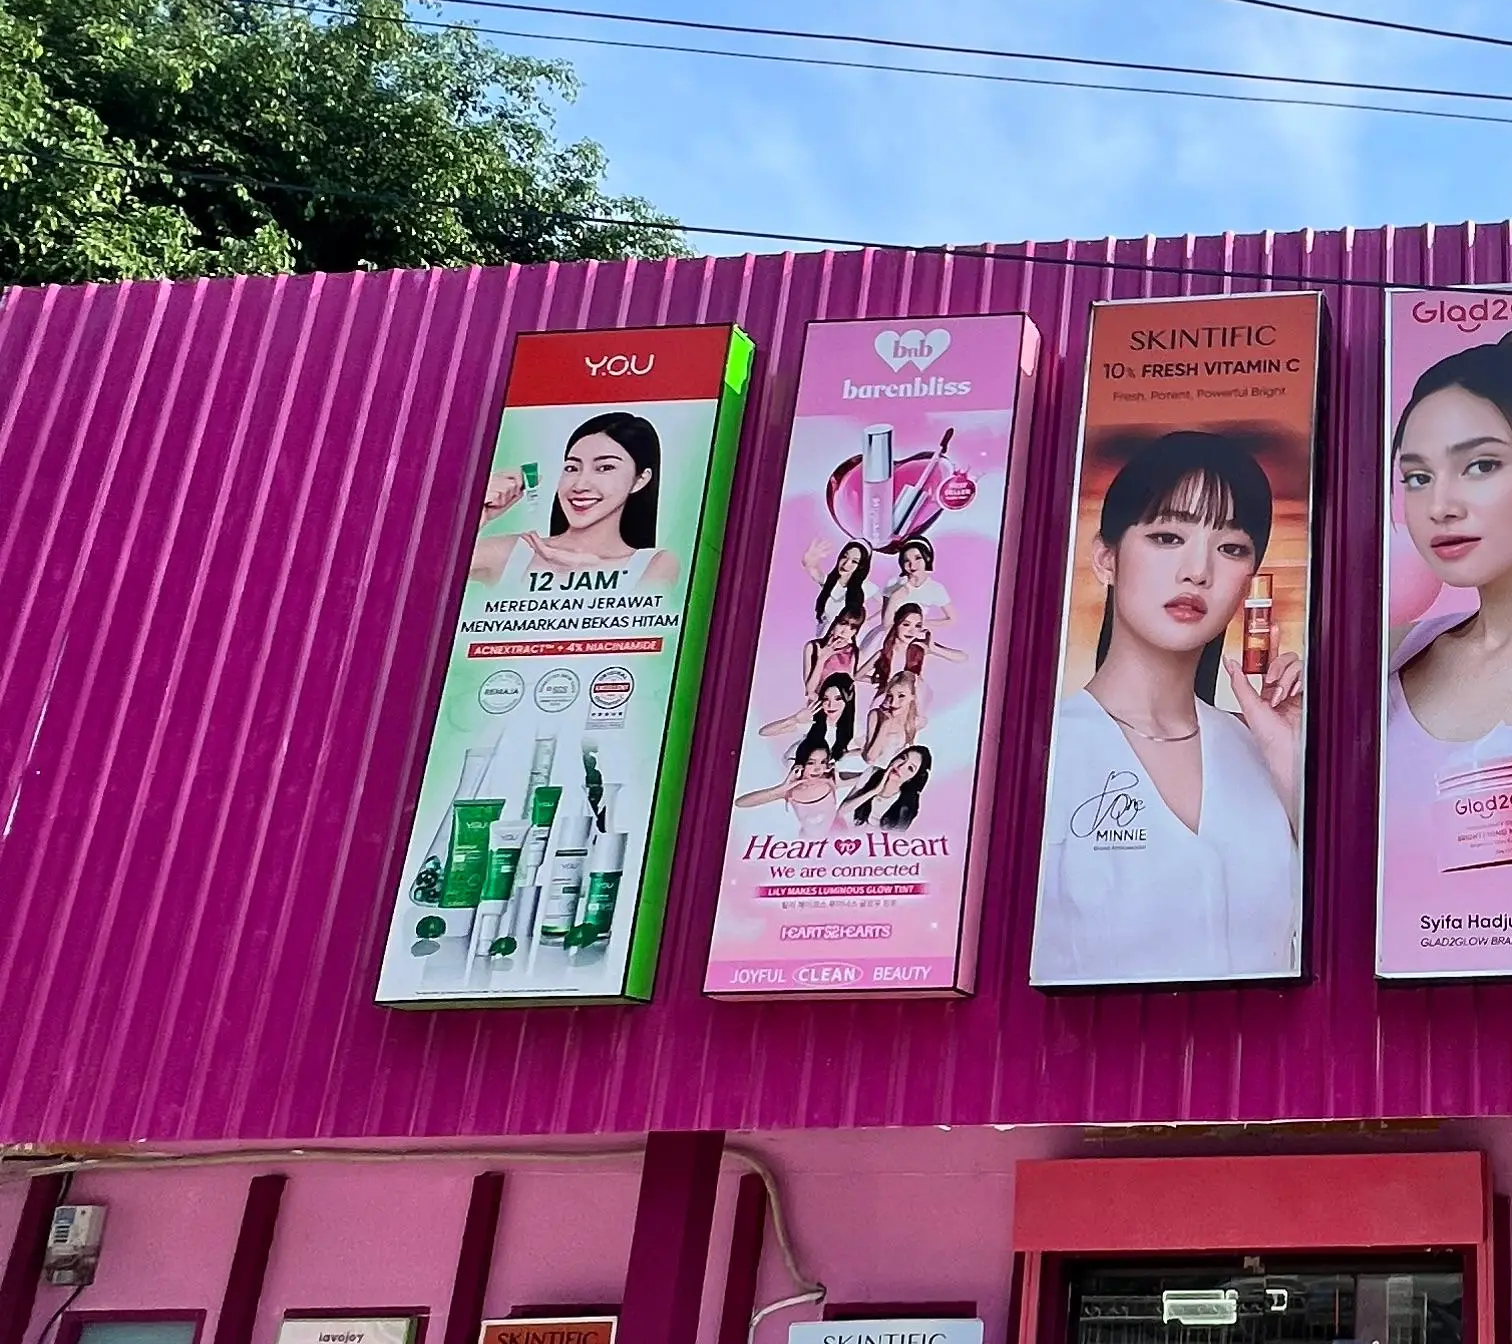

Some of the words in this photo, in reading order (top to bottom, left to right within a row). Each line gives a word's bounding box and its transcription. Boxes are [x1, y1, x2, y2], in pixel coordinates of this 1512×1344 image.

[1129, 325, 1277, 351] SKINTIFIC
[893, 340, 933, 358] bnb
[1103, 362, 1136, 379] 10%
[1141, 363, 1199, 378] FRESH
[1204, 359, 1281, 375] VITAMIN
[1285, 359, 1300, 372] C
[842, 377, 972, 399] barenbliss
[1197, 387, 1248, 398] Powerful
[1251, 386, 1287, 399] Bright
[528, 572, 552, 592] 12
[484, 598, 584, 614] MEREDAKAN
[587, 595, 663, 611] JERAWAT
[460, 617, 579, 634] MENYAMARKAN
[581, 616, 630, 631] BEKAS
[631, 614, 679, 628] HITAM
[565, 642, 585, 653] 4%
[585, 640, 658, 652] NIACINAMIDE
[1096, 829, 1146, 842] MINNIE
[742, 834, 828, 860] Heart
[866, 832, 950, 857] Heart
[770, 866, 795, 879] We
[799, 867, 827, 878] are
[831, 863, 920, 878] connected
[767, 887, 787, 896] LILY
[787, 886, 817, 896] MAKES
[818, 886, 866, 895] LUMINOUS
[866, 885, 894, 895] GLOW
[894, 885, 915, 893] TINT
[1420, 915, 1463, 933] Syifa
[1420, 936, 1489, 947] GLAD2GLOW
[730, 968, 786, 984] JOYFUL
[797, 966, 857, 982] CLEAN
[872, 966, 932, 981] BEAUTY
